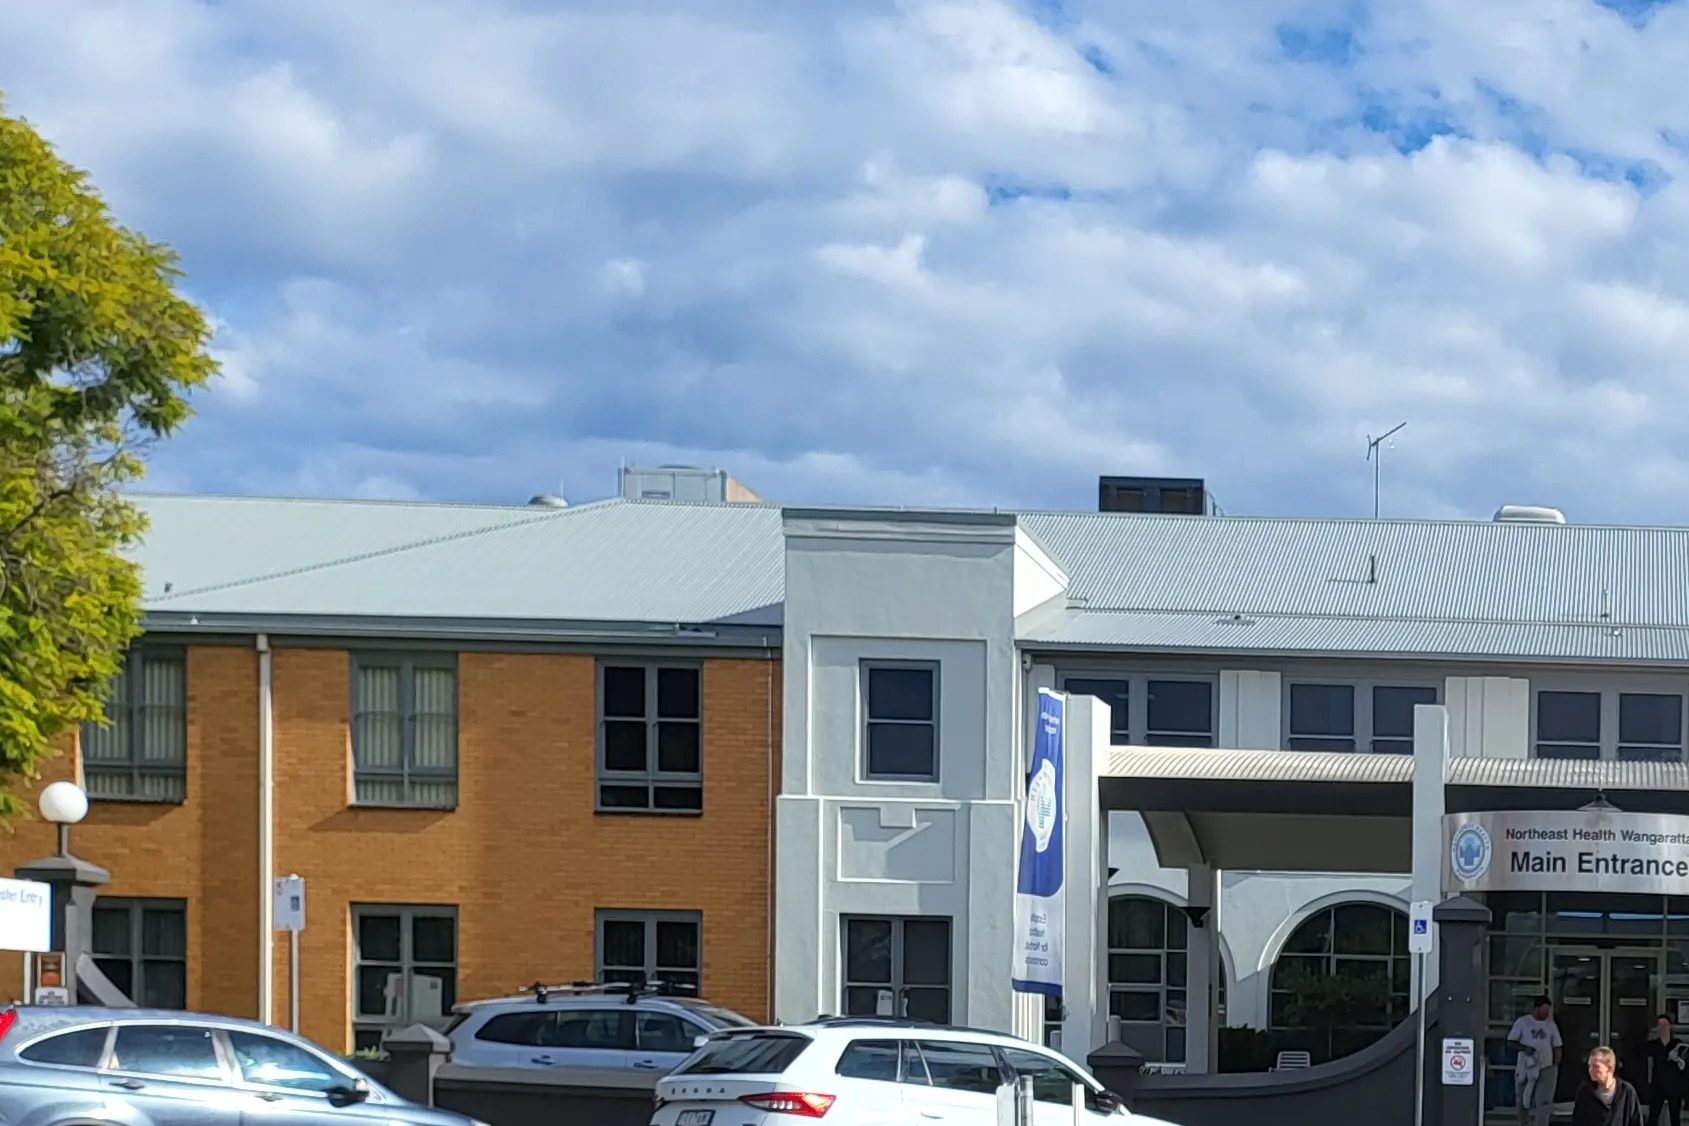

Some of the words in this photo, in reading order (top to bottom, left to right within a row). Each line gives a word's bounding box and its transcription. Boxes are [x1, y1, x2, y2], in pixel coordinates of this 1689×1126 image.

[1505, 828, 1568, 841] Northeast
[1572, 828, 1616, 842] Health
[1510, 851, 1567, 873] Main
[1577, 852, 1689, 877] Entrance
